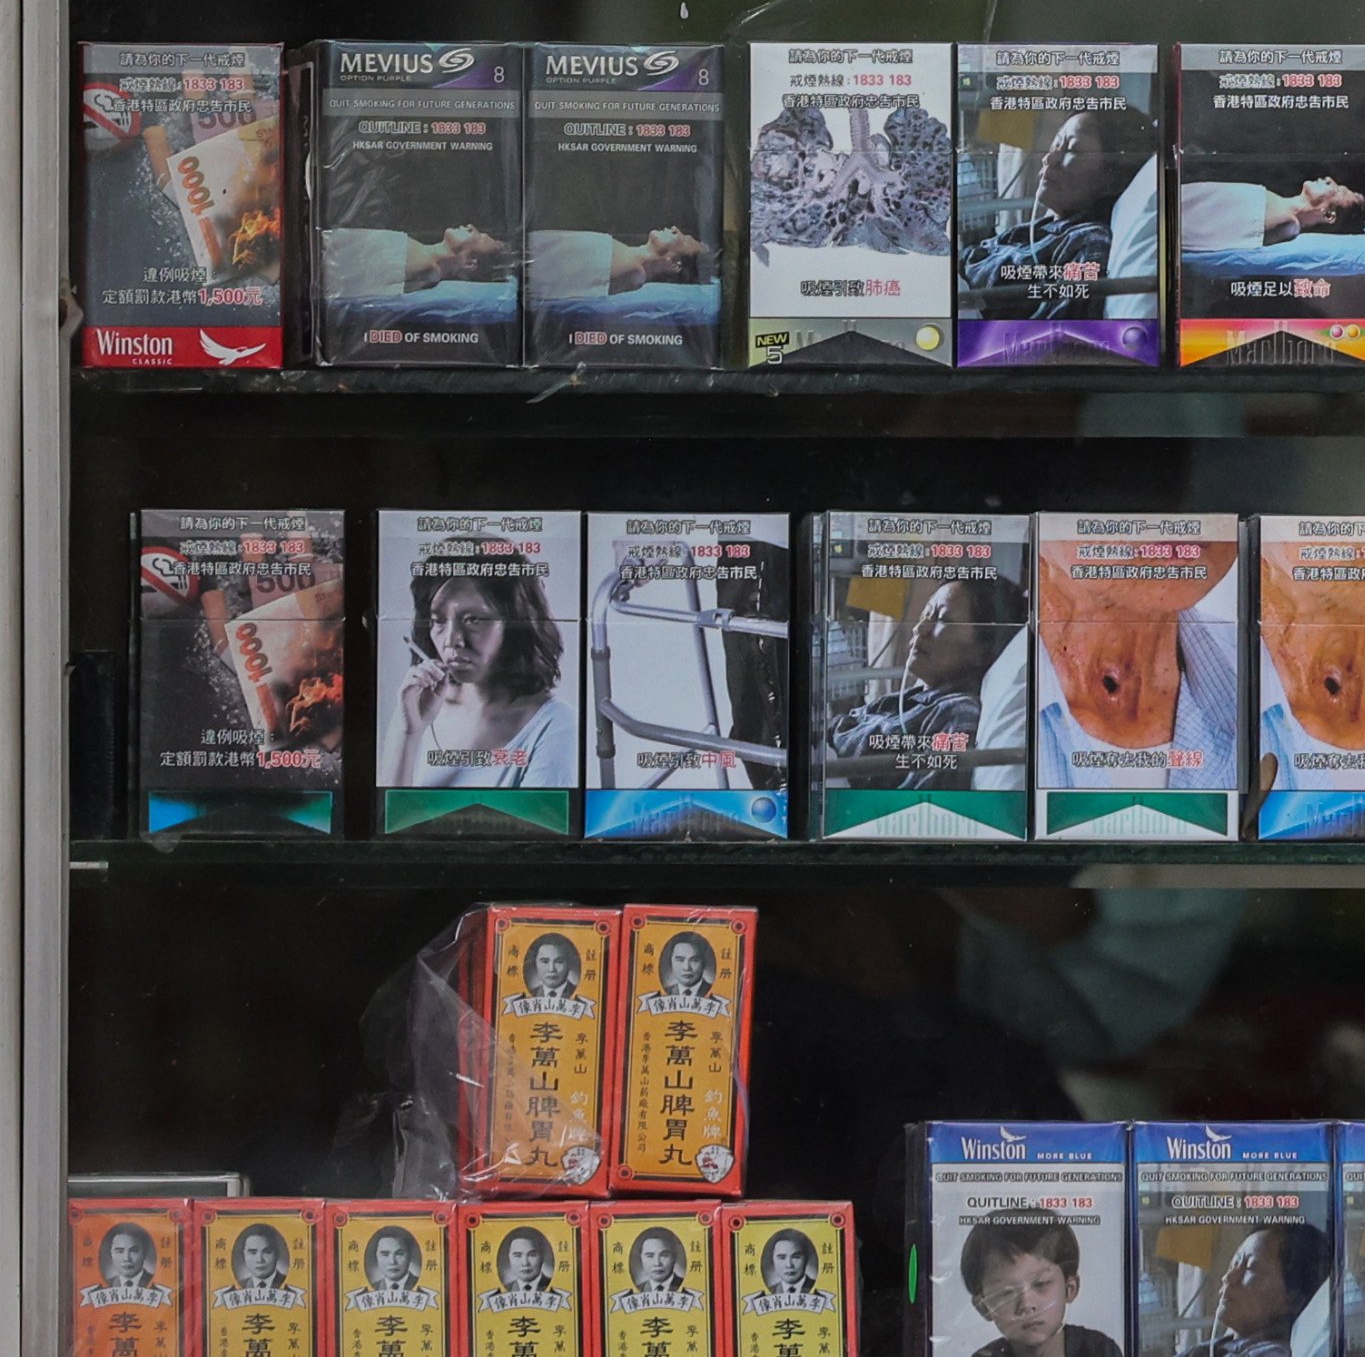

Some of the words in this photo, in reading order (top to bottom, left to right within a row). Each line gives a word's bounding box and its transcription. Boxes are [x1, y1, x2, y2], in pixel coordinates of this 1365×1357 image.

[339, 52, 434, 76] MEVIUS
[494, 66, 504, 84] 8
[96, 331, 174, 358] Winston
[960, 1136, 1027, 1160] Winston
[1166, 1136, 1232, 1160] Winston
